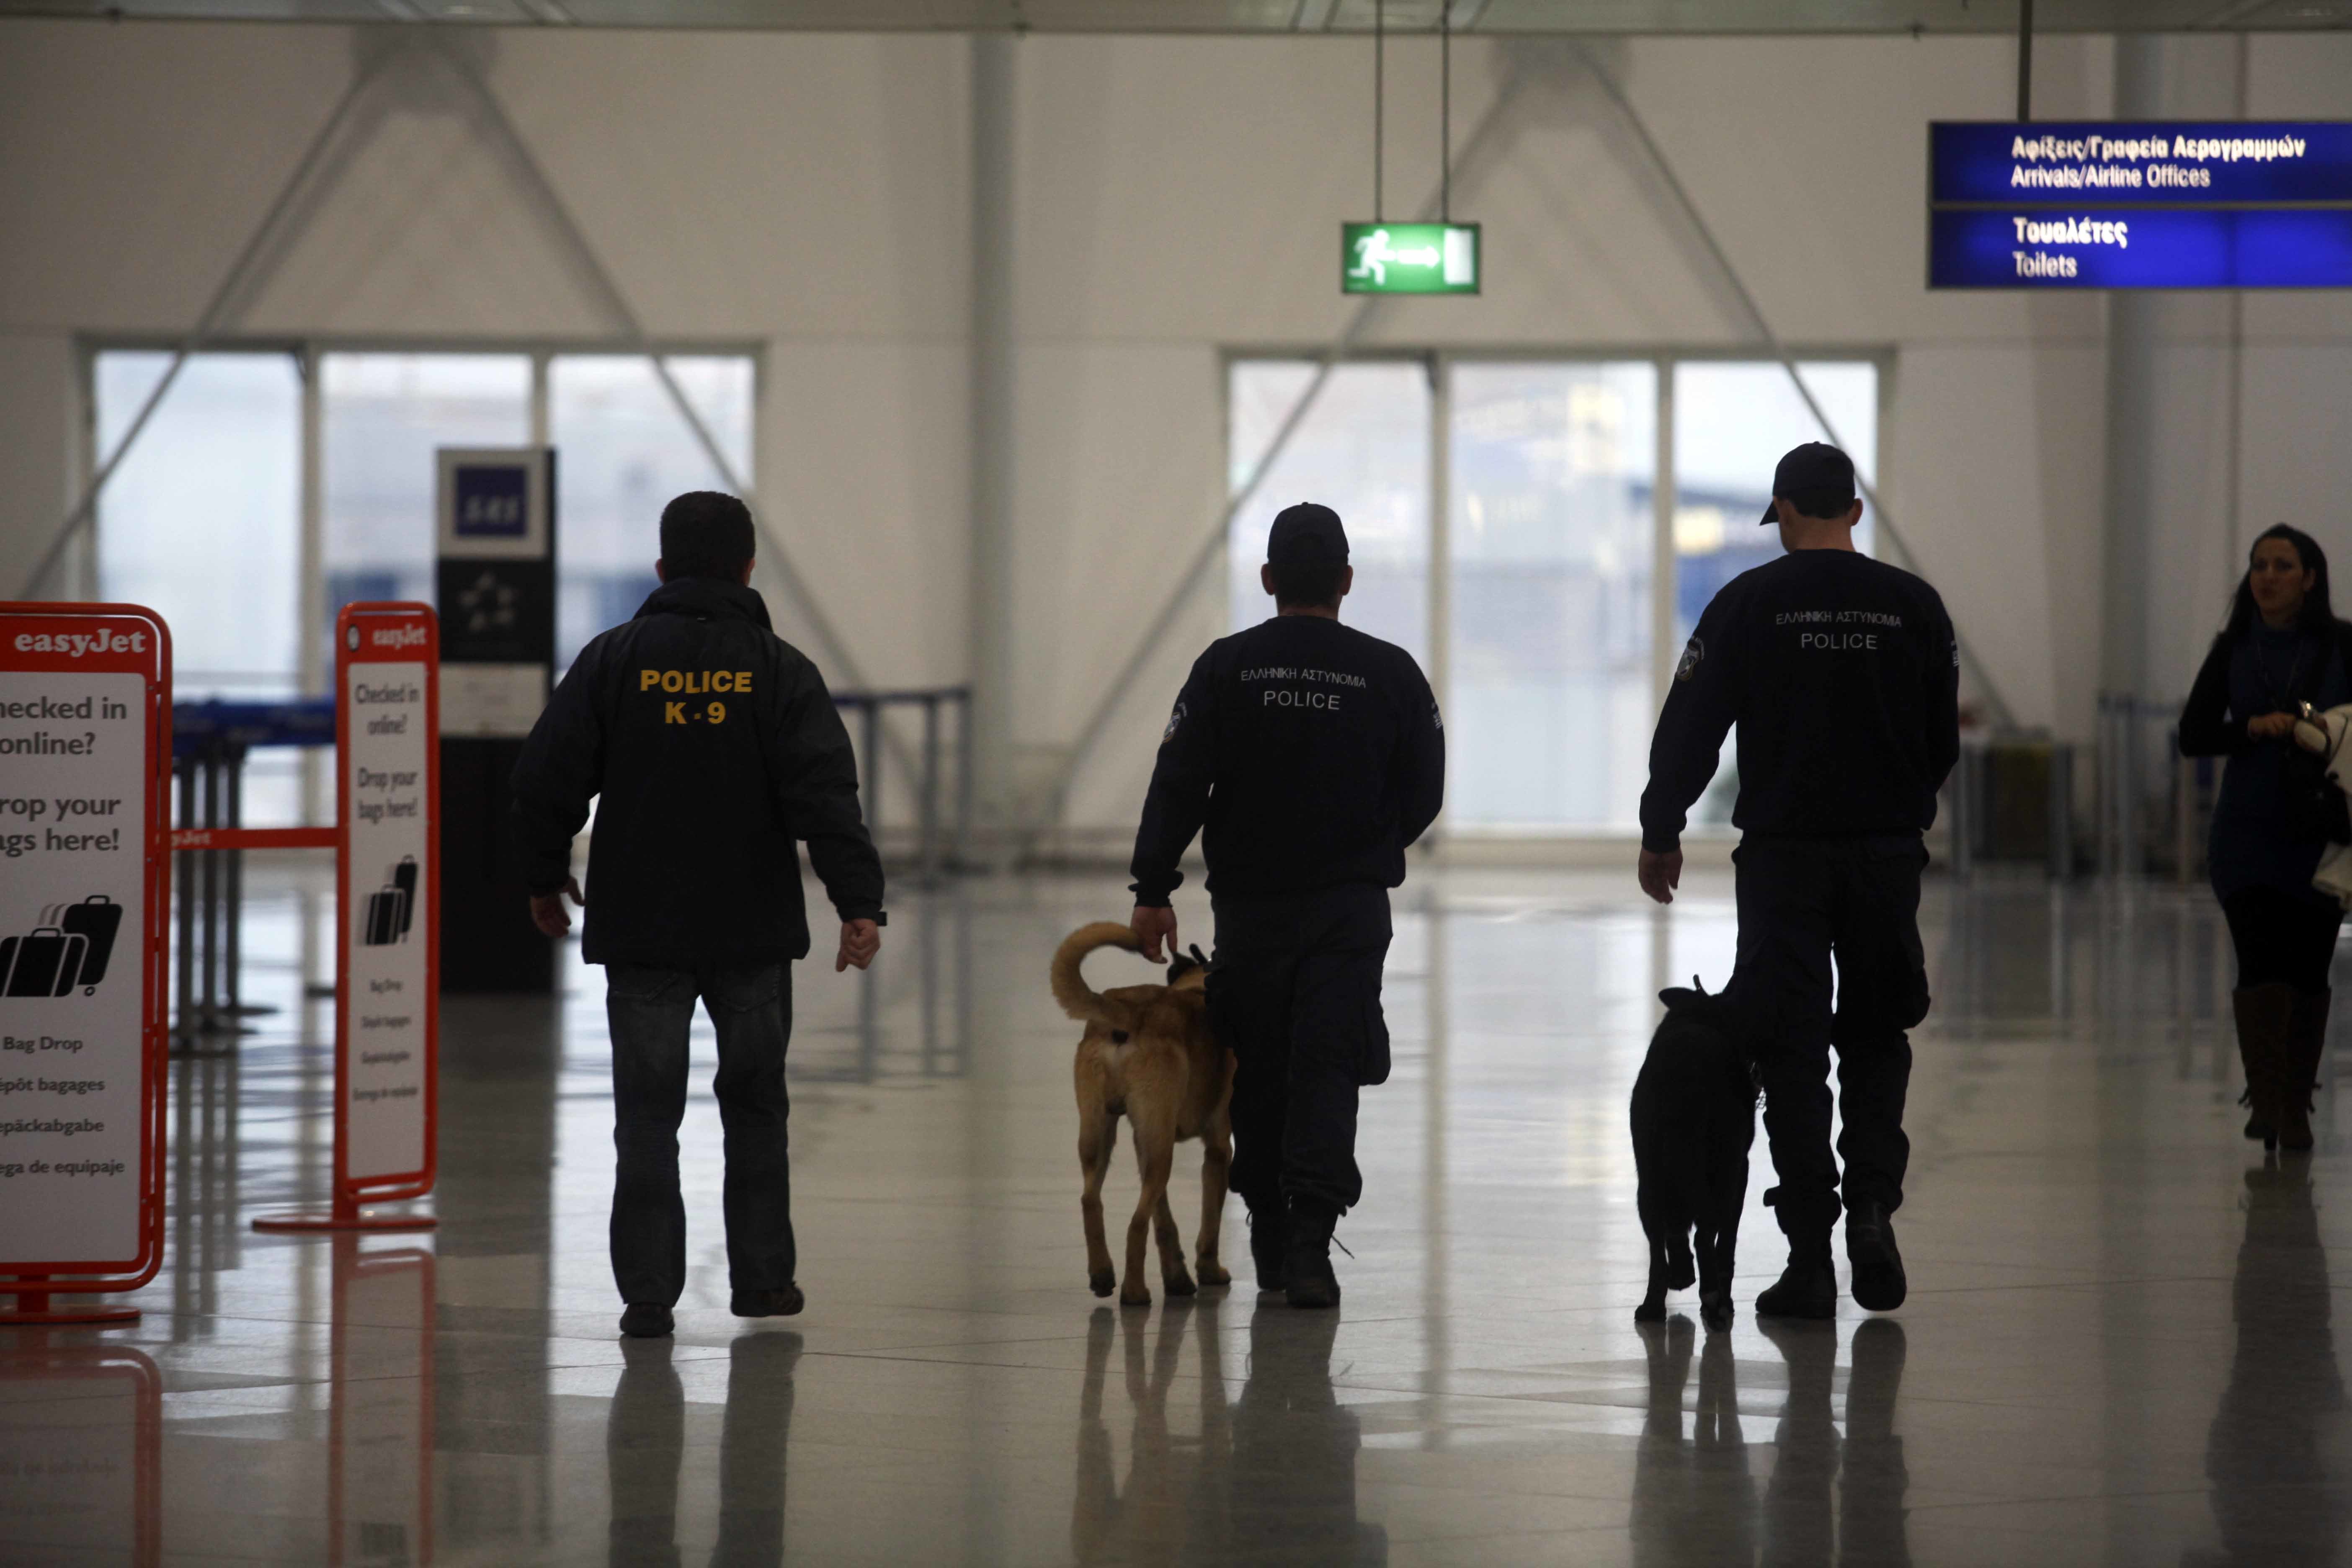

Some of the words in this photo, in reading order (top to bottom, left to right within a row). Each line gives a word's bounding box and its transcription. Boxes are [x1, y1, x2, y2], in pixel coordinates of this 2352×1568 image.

[2173, 134, 2305, 162] Αερογραμμών
[2012, 165, 2142, 188] Arrivals/Airline
[2147, 164, 2210, 187] Offices
[2014, 217, 2128, 248] Τουαλέτες
[2013, 252, 2077, 276] Toilets
[1777, 611, 1831, 624] ΕΛΛΗΝΙΚΗ
[1836, 611, 1901, 627] ΑΣΤΥΝΟΜΙΑ
[15, 629, 146, 657] easyJet
[1802, 634, 1877, 649] POLICE
[641, 670, 752, 693] POLICE
[1241, 668, 1296, 680] ΕΛΛΗΝΙΚΗ
[1301, 669, 1366, 688] ΑΣΤΥΝΟΜΙΑ
[103, 697, 126, 719] in
[1264, 691, 1340, 710] POLICE
[0, 732, 95, 755] online?
[55, 799, 121, 821] your
[46, 828, 119, 851] here!
[3, 1037, 35, 1054] Bag
[40, 1037, 83, 1053] Drop
[38, 1078, 105, 1095] bagages
[29, 1160, 49, 1173] de
[54, 1160, 124, 1176] equipaje
